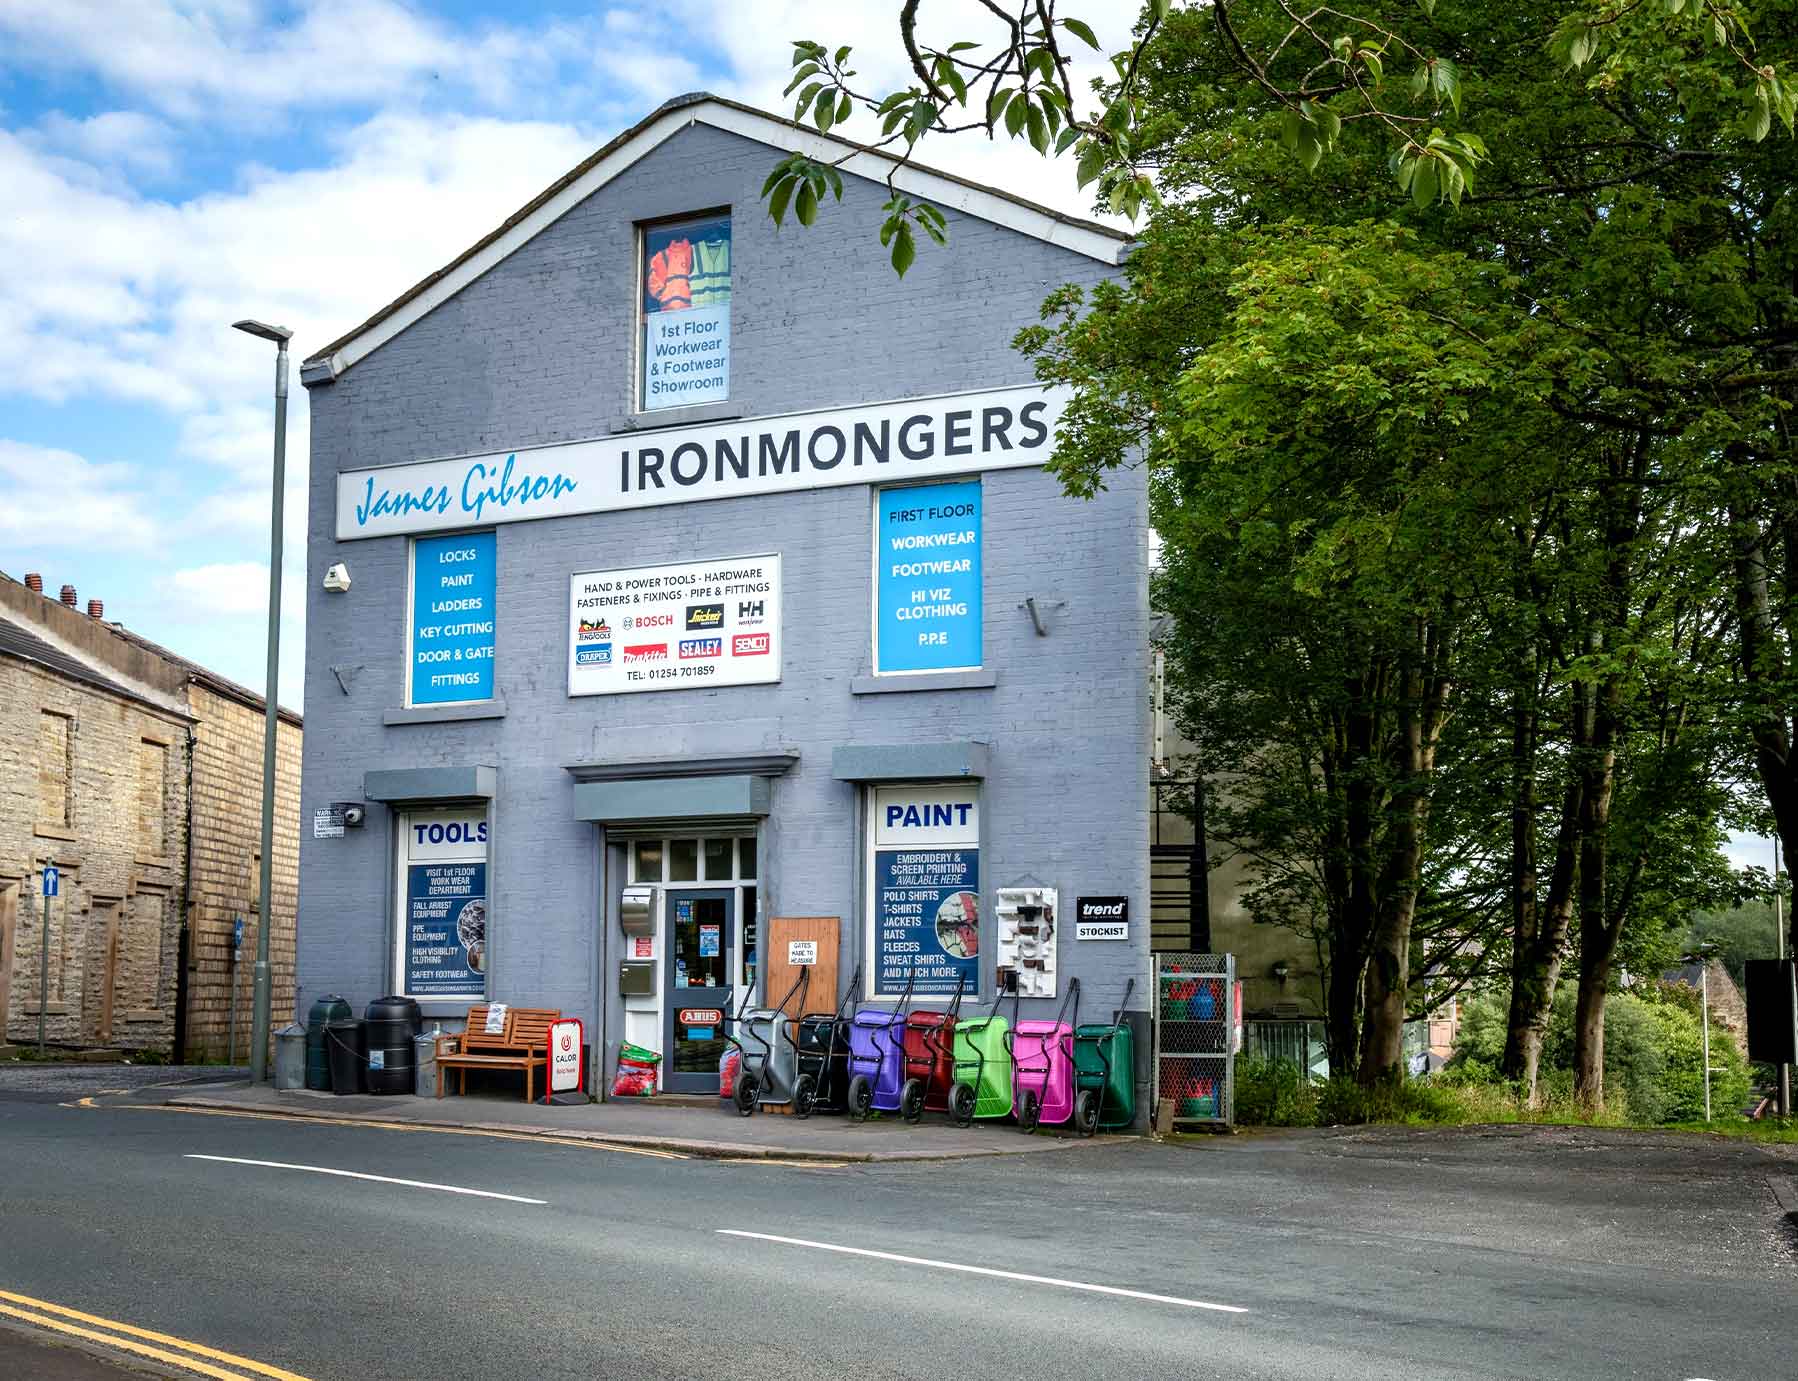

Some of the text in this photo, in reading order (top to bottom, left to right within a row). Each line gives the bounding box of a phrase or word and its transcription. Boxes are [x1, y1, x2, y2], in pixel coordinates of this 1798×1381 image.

[661, 320, 719, 338] 1st Floor
[655, 338, 723, 357] Workwear
[650, 356, 726, 376] & Footwear
[651, 375, 724, 394] Showroom
[356, 400, 1049, 526] James Gibson IRONMONGERS
[889, 504, 975, 524] FIRST FLOOR
[891, 530, 976, 551] WORKWEAR
[439, 549, 477, 564] LOCKS
[891, 559, 972, 578] FOOTWEAR
[441, 574, 474, 588] PAINT
[584, 568, 762, 594] HAND & POWER TOOLS HARDWARE
[577, 582, 770, 608] FASTENERS & FIXINGS PIPE & FITTINGS
[911, 587, 952, 604] HI VIZ
[431, 598, 482, 613] LADDERS
[738, 600, 764, 618] HH
[896, 601, 968, 622] CLOTHING
[635, 615, 673, 628] BOSCH
[420, 621, 493, 639] KEY CUTTING
[917, 631, 948, 647] P.P.E
[418, 646, 495, 664] DOOR & GATE
[681, 640, 720, 657] SEALEY
[431, 671, 480, 687] FITTINGS
[627, 665, 715, 681] TEL: 01254 701859
[886, 803, 973, 828] PAINT
[413, 822, 487, 845] TOOLS
[896, 853, 961, 864] EMBROIDERY &
[426, 867, 476, 877] VISIT 1st FLOOR
[890, 864, 967, 875] SCREEN PRINTING
[430, 876, 470, 886] WORK WEAR
[896, 874, 963, 886] AVAILABLE HERE
[428, 886, 472, 895] DEPARTMENT
[883, 890, 940, 902] POLO SHIRTS
[414, 901, 452, 910] FALL ARREST
[883, 903, 922, 914] T-SHIRTS
[1083, 902, 1123, 915] trend
[413, 910, 448, 918] EQUIPMENT
[883, 916, 922, 927] JACKETS
[412, 924, 424, 933] PPE
[883, 929, 906, 940] HATS
[1080, 928, 1124, 936] STOCKIST
[412, 932, 447, 942] EQUIPMENT
[412, 946, 458, 956] HIGH VISIBILITY
[883, 942, 921, 952] FLEECES
[412, 956, 442, 964] CLOTHING
[883, 954, 946, 966] SWEAT SHIRTS
[412, 970, 468, 979] SAFETY FOOTWEAR
[883, 967, 902, 978] AND
[931, 967, 960, 978] MORE.
[684, 1012, 717, 1021] ABUS
[556, 1054, 577, 1063] CALOR
